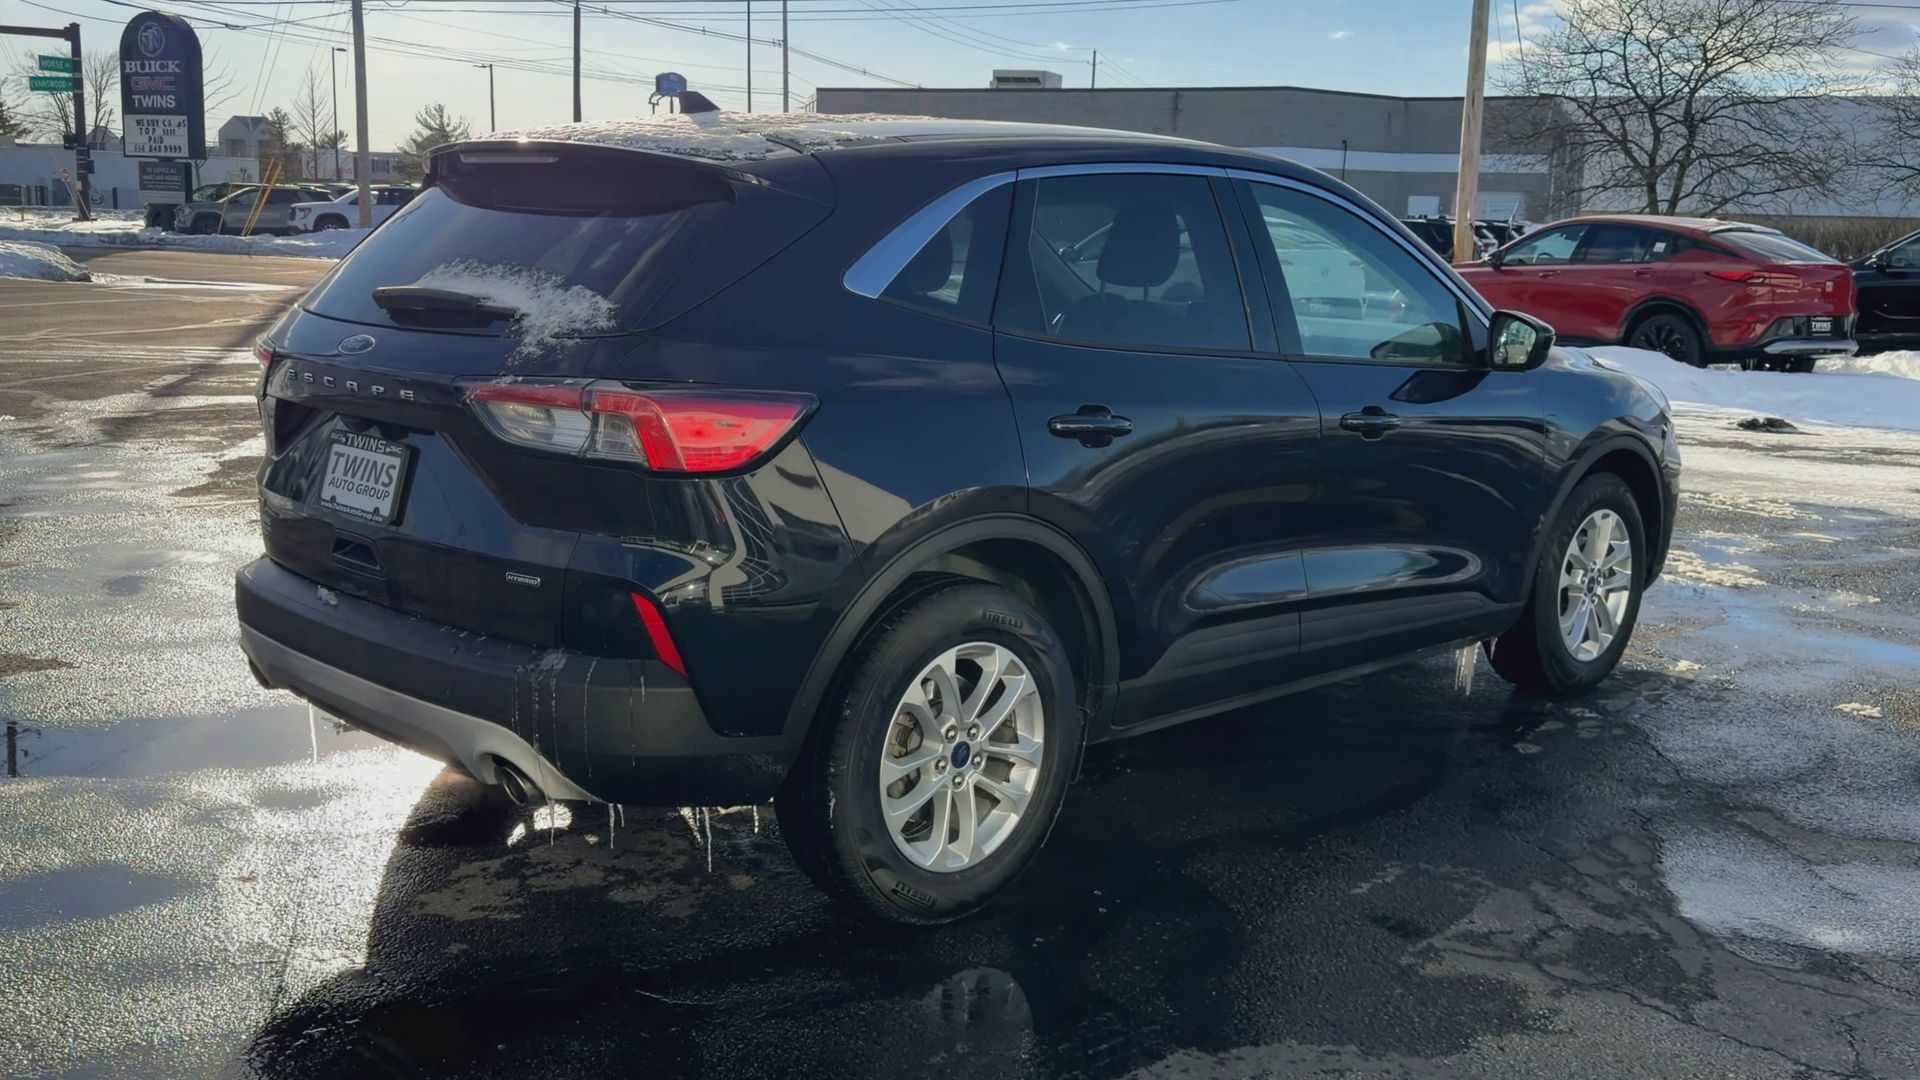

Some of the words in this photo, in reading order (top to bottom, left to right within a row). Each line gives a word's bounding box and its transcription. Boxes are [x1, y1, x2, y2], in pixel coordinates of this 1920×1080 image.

[41, 59, 65, 68] MORSE
[124, 60, 181, 73] BUICK
[131, 76, 176, 91] GMC
[131, 94, 176, 108] TWINS
[139, 127, 157, 135] TOP
[148, 136, 164, 144] PAID
[163, 145, 182, 153] 9999
[287, 368, 414, 401] ESCAPE
[346, 433, 386, 453] TWINS
[331, 450, 397, 488] TWINS
[328, 476, 355, 492] AUTO
[355, 483, 390, 501] GROUP
[507, 574, 538, 585] HYBRID
